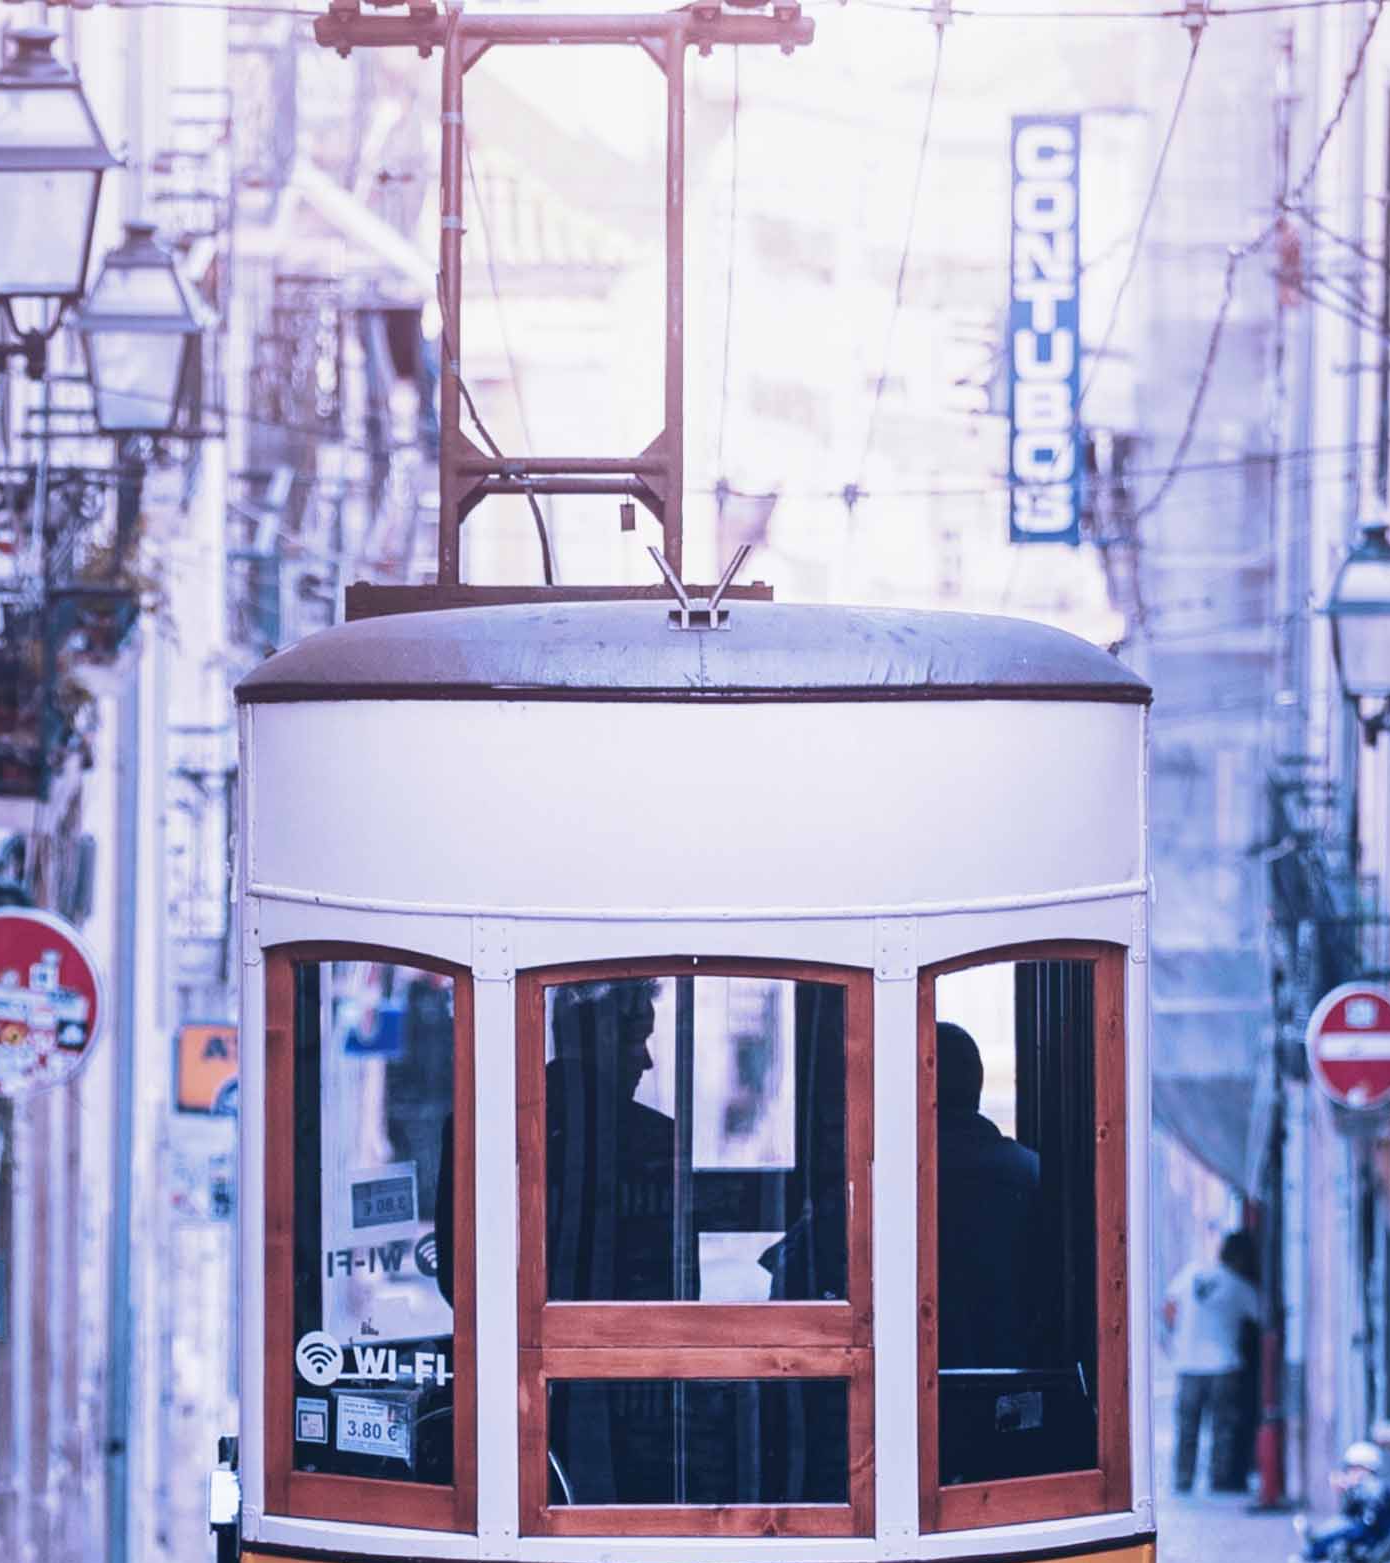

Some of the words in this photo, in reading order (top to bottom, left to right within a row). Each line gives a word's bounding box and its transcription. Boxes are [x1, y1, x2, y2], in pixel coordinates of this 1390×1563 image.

[1013, 125, 1075, 533] CONTUBOS
[353, 1346, 446, 1387] WI-FI
[347, 1419, 382, 1440] 3.80
[387, 1424, 398, 1442] €
